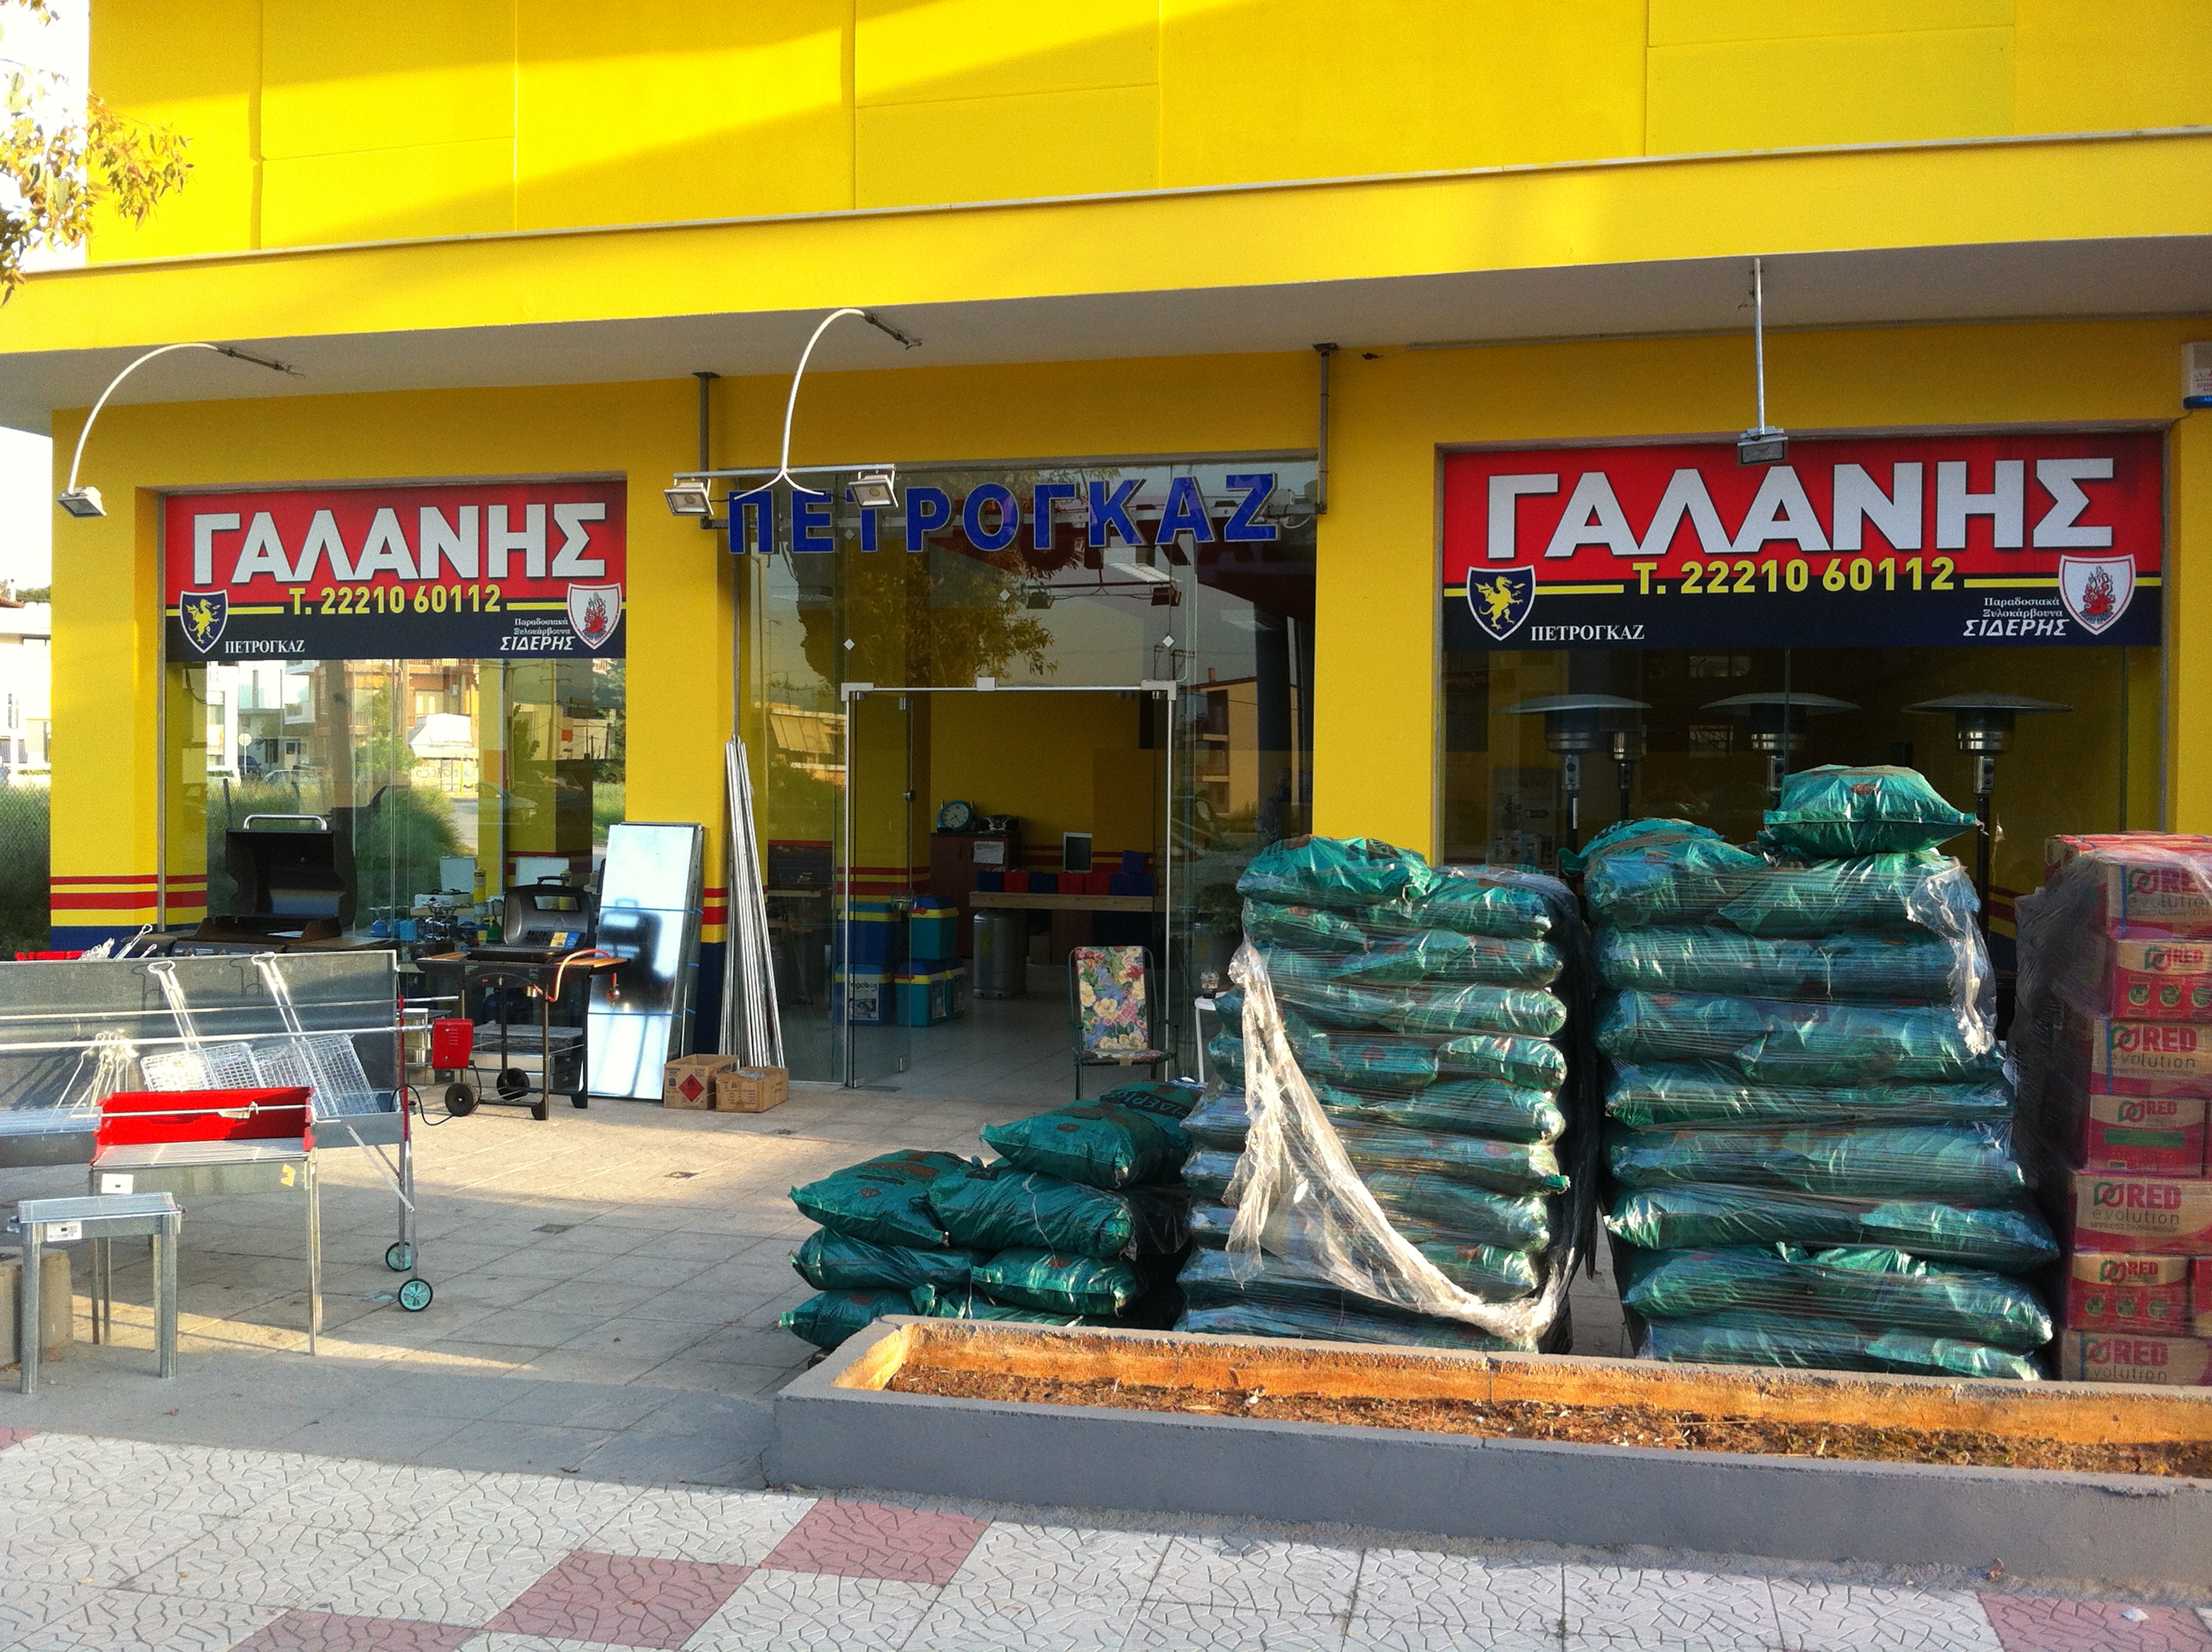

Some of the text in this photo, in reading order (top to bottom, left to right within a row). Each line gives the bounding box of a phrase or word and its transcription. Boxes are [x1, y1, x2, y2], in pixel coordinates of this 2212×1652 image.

[1487, 458, 2114, 559] ΓΑΛΑΝΗΣ
[194, 503, 606, 584] ΓΑΛΑΝΗΣ
[1633, 557, 1954, 595] Τ. 22210 60112
[289, 585, 501, 615] Τ. 22210 60112
[1984, 597, 2060, 608] Παραδοσιακά
[1982, 608, 2064, 619] Ξυλοκάρβουνα
[1530, 625, 1644, 642] ΠΕΤΡΟΓΚΑΖ
[1963, 619, 2070, 637] ΣΙΔΕΡΗΣ
[225, 638, 305, 654] ΠΕΤΡΟΓΚΑΖ
[500, 637, 576, 650] ΣΙΔΕΡΗΣ
[2092, 1208, 2180, 1225] evolution
[2086, 1365, 2168, 1382] volution
